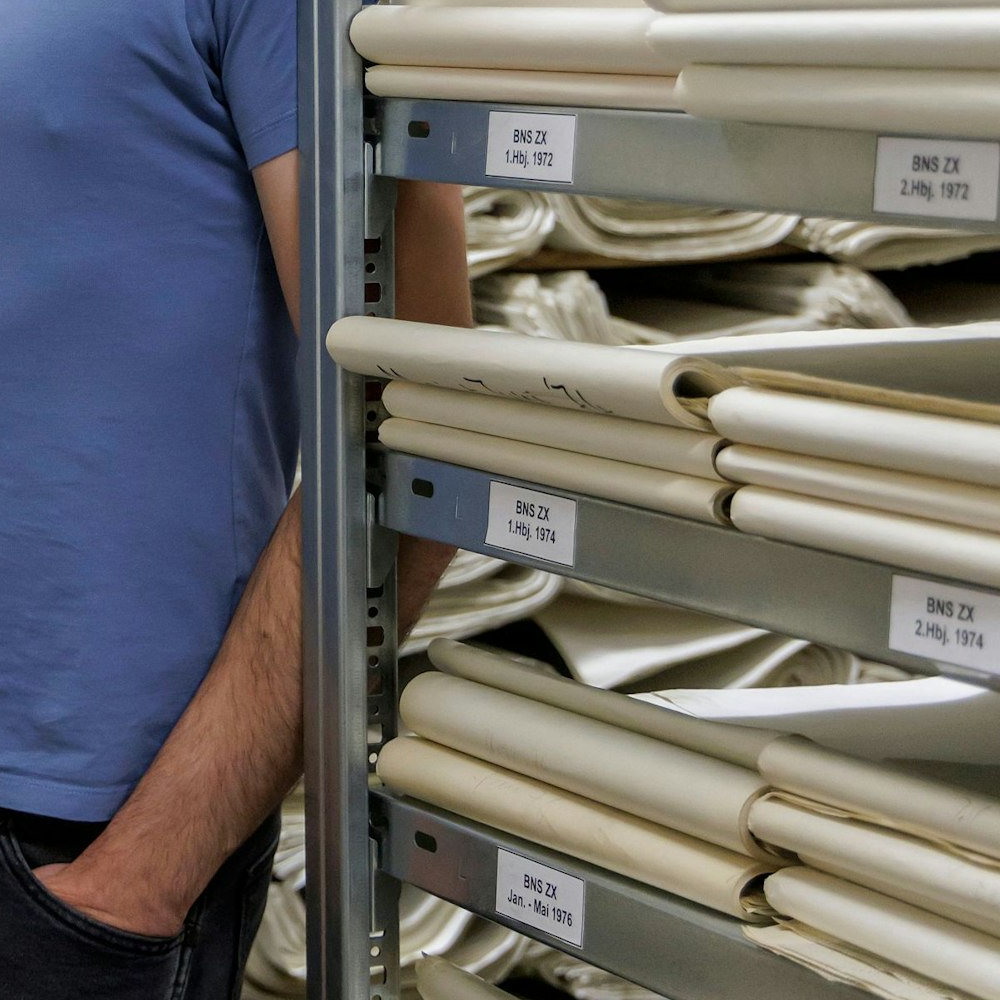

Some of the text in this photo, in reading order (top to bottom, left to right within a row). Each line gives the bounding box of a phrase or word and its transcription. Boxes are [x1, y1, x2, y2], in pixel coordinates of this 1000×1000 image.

[513, 129, 548, 145] BNS ZX
[505, 148, 554, 169] 1.Hbj. 1972
[911, 154, 960, 175] BNS ZX
[900, 178, 969, 203] 2.Hbj. 1972
[515, 499, 550, 522] BNS ZX
[508, 519, 556, 545] 1.Hbj. 1974
[926, 596, 975, 623] BNS ZX
[914, 618, 984, 651] 2.Hbj. 1974
[523, 873, 558, 900] BNS ZX
[507, 888, 526, 909] Jan.
[533, 898, 550, 918] Mai
[551, 906, 573, 928] 1976
